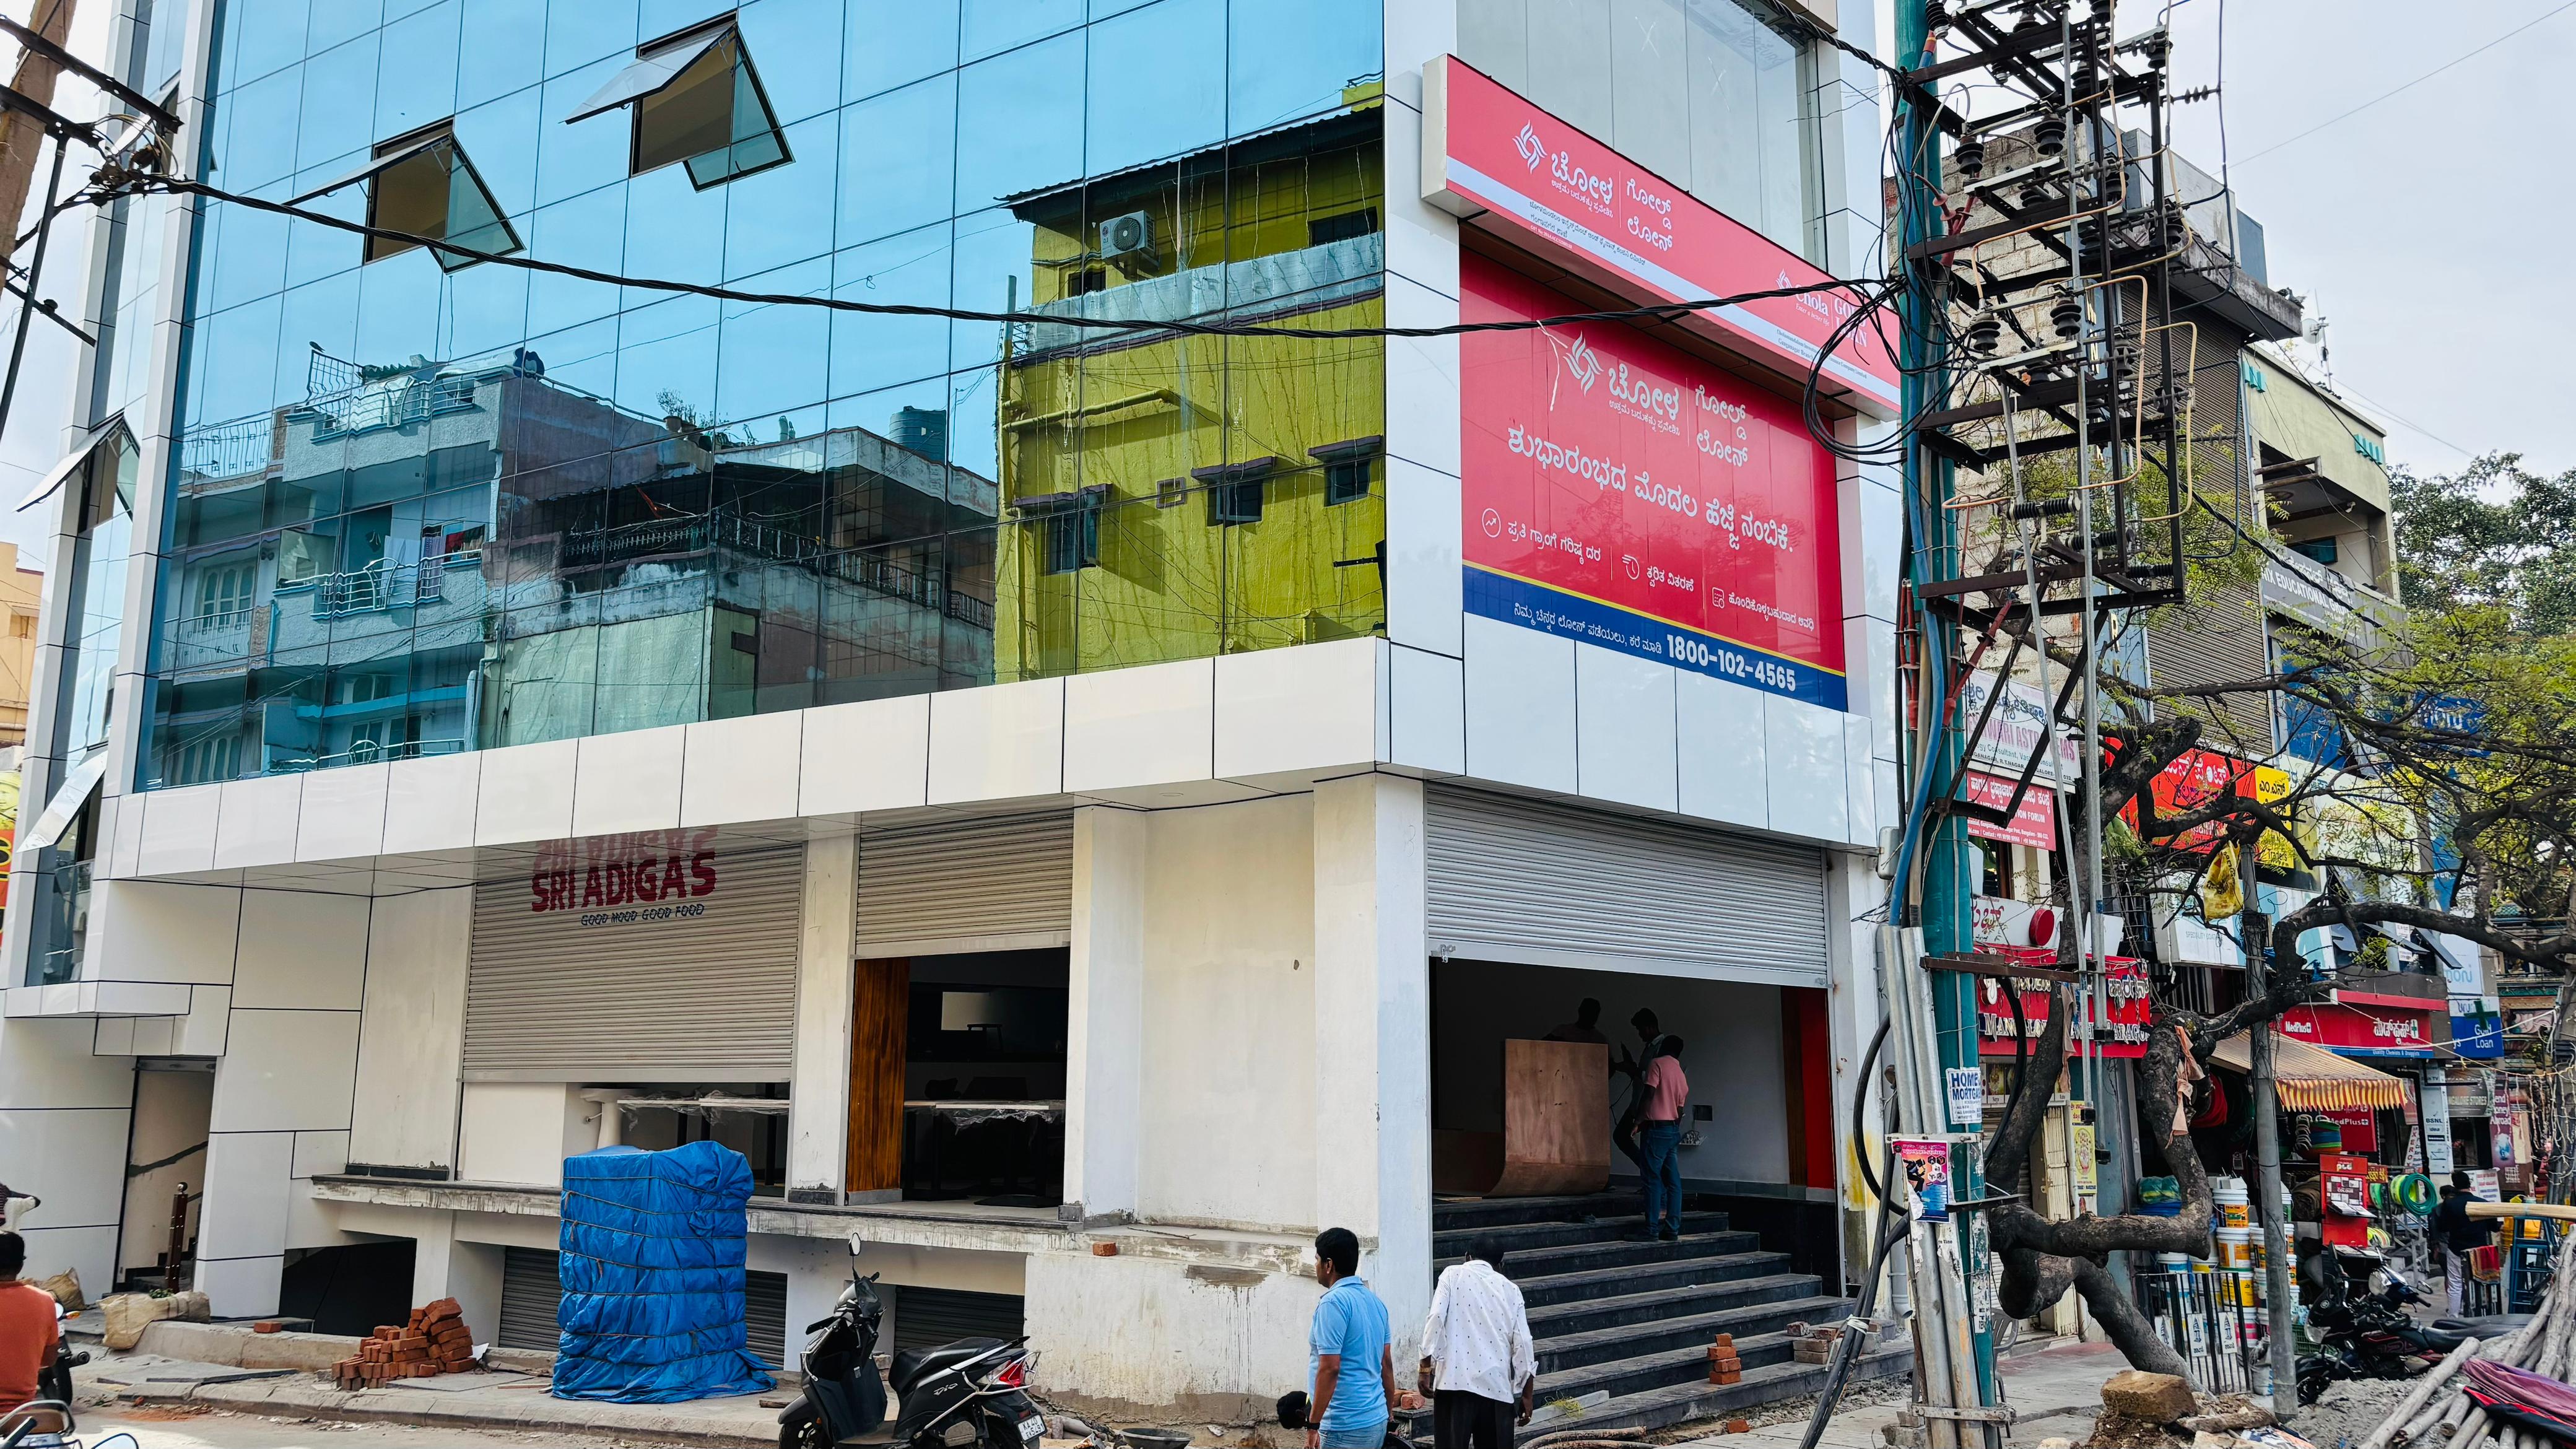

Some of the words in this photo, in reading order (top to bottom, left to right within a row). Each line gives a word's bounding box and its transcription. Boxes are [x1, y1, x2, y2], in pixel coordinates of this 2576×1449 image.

[1551, 150, 1613, 204] ಚೋಳ
[1627, 178, 1671, 229] ಗೋಲ್ಡ್
[1627, 216, 1672, 251] ಲೋನ್
[1609, 363, 1679, 420] ಚೋಳ
[1695, 384, 1747, 440] ಗೋಲ್ಡ್
[1609, 399, 1630, 414] ಉತ್ತಮ
[1630, 409, 1657, 432] ಬದುಕನ್ನು
[1697, 429, 1748, 467] ಲೋನ್
[1507, 424, 1627, 492] ಶುಭಾರಂಭದ
[1634, 471, 1698, 517] ಮೊದಲ
[1705, 498, 1739, 550] ಹೆಜ್ಜೆ
[1741, 510, 1794, 552] ನಂಬಿಕೆ.
[1508, 521, 1526, 542] ಪ್ರತಿ
[1530, 528, 1557, 550] ಗ್ರಾಂಗೆ
[1560, 536, 1584, 565] ಗರಿಷ್ಠ
[1586, 545, 1601, 562] ದರ
[1647, 565, 1664, 588] ತ್ವರಿತ
[1667, 572, 1694, 593] ವಿತರಣೆ
[2276, 573, 2328, 609] EDUCATIONAL
[1728, 591, 1796, 622] ಹೊಂದಿಕೊಳ್ಳಬಹುದಾದ
[1514, 602, 1536, 625] ನಿಮ್ಮ
[1536, 609, 1556, 632] ಚಿನ್ನದ
[1558, 614, 1586, 633] ಲೋನ್
[1588, 623, 1627, 646] ಪಡೆಯಲು,
[1629, 635, 1641, 648] ಕರೆ
[1642, 639, 1662, 655] ಮಾಡಿ
[1667, 634, 1796, 692] 1800-102-4565
[2027, 811, 2045, 823] FORUM
[531, 869, 577, 913] SRI
[581, 851, 717, 908] ADIGAS
[581, 913, 609, 926] GOOD
[611, 910, 638, 923] MOOD
[642, 907, 672, 921] GOOD
[675, 903, 705, 917] FOOD
[2286, 1021, 2307, 1033] MedPlus
[2475, 1037, 2494, 1048] Loan
[1951, 1072, 1978, 1087] HOME
